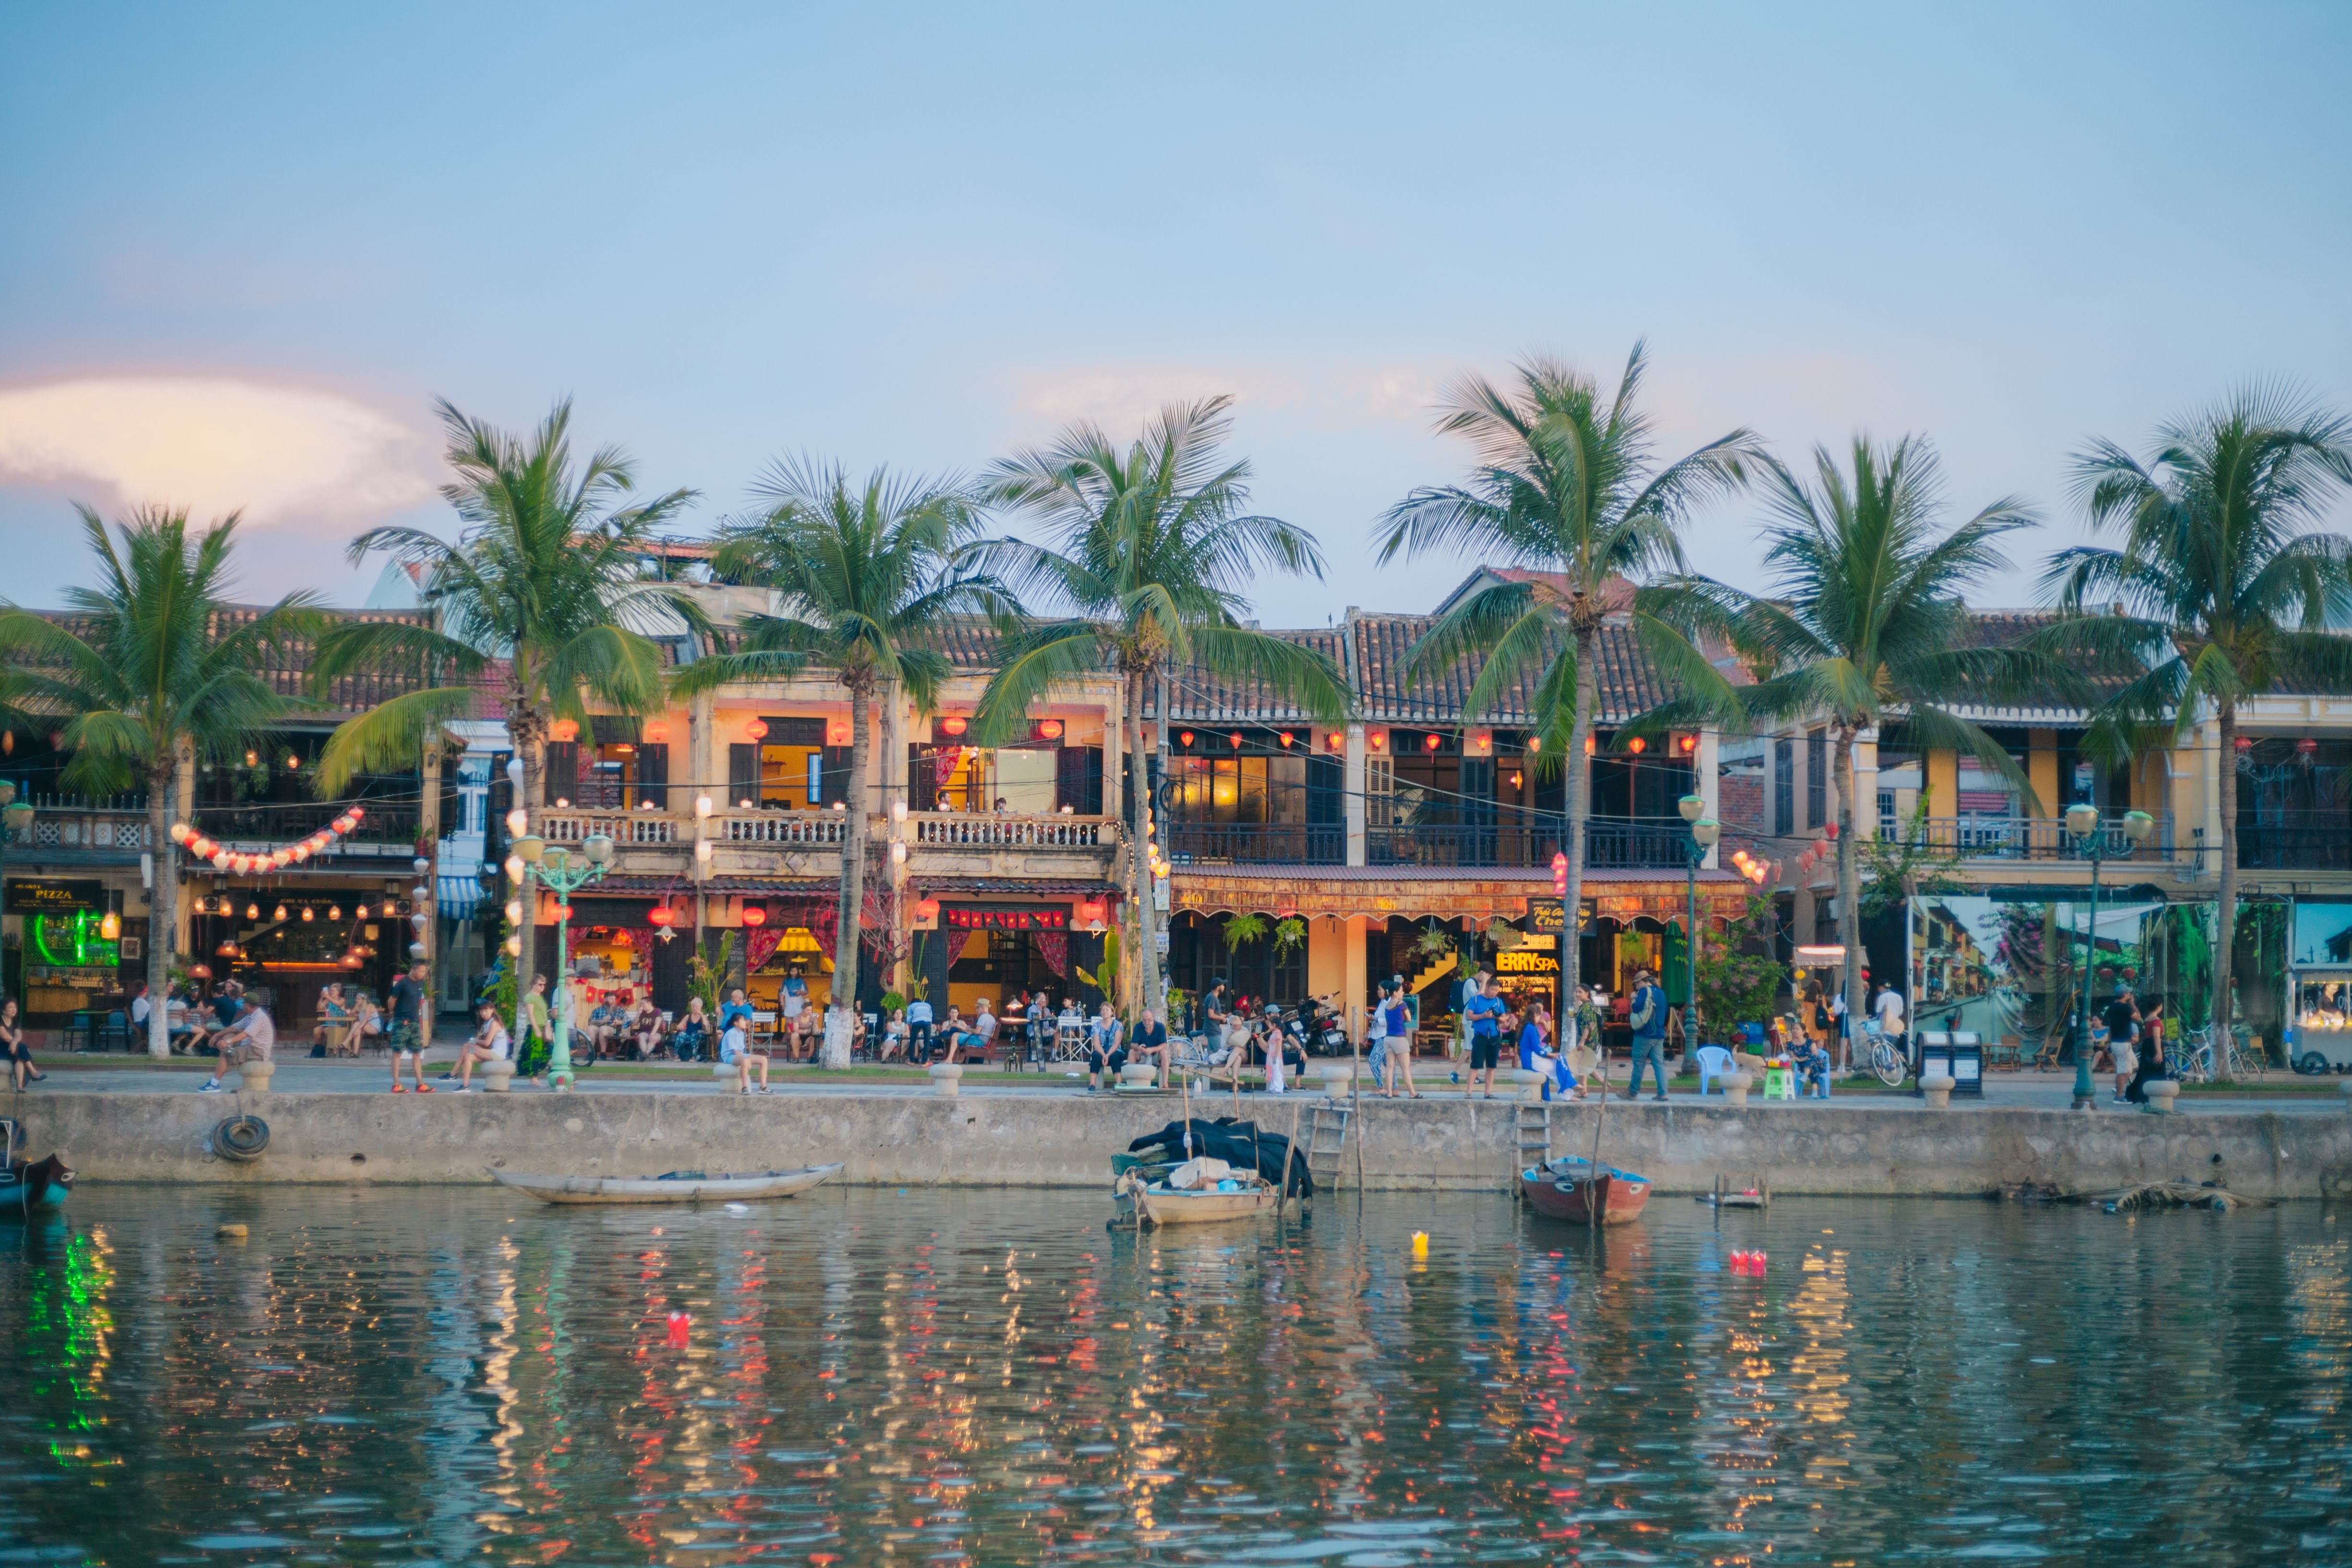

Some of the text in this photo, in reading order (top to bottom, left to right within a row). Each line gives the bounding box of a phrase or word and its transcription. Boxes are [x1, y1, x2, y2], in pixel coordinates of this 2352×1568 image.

[35, 890, 72, 899] PIZZA
[1552, 907, 1564, 916] An
[1535, 915, 1588, 928] Chey
[1535, 958, 1560, 971] SPA
